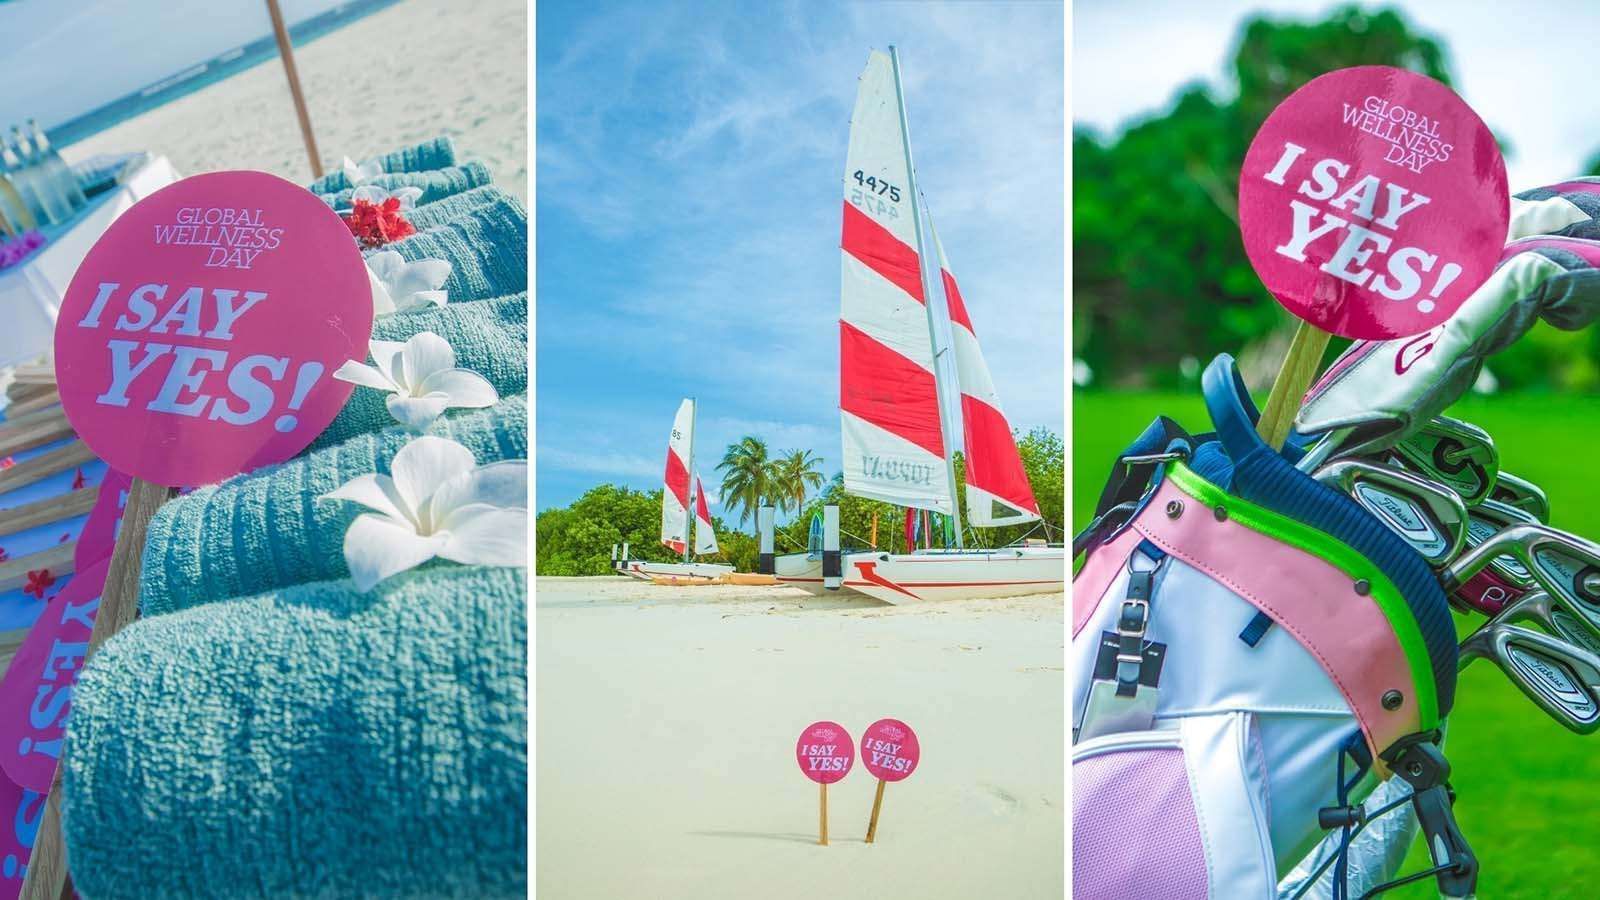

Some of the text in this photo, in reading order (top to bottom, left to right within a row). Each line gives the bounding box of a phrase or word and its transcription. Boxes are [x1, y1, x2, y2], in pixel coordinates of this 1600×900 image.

[1364, 96, 1441, 139] GLOBAL
[1342, 103, 1454, 163] WELLNESS
[1384, 144, 1435, 174] DAY
[853, 169, 901, 203] 4475
[1263, 142, 1431, 231] I SAY
[176, 207, 265, 227] GLOBAL
[154, 225, 285, 249] WELLNESS
[205, 248, 263, 270] DAY
[1275, 199, 1463, 314] YES!
[78, 283, 267, 341] I SAY
[96, 339, 324, 432] YES!
[801, 745, 837, 756] I SAY
[865, 738, 901, 755] I SAY
[809, 757, 849, 771] YES!
[871, 751, 912, 773] YES!
